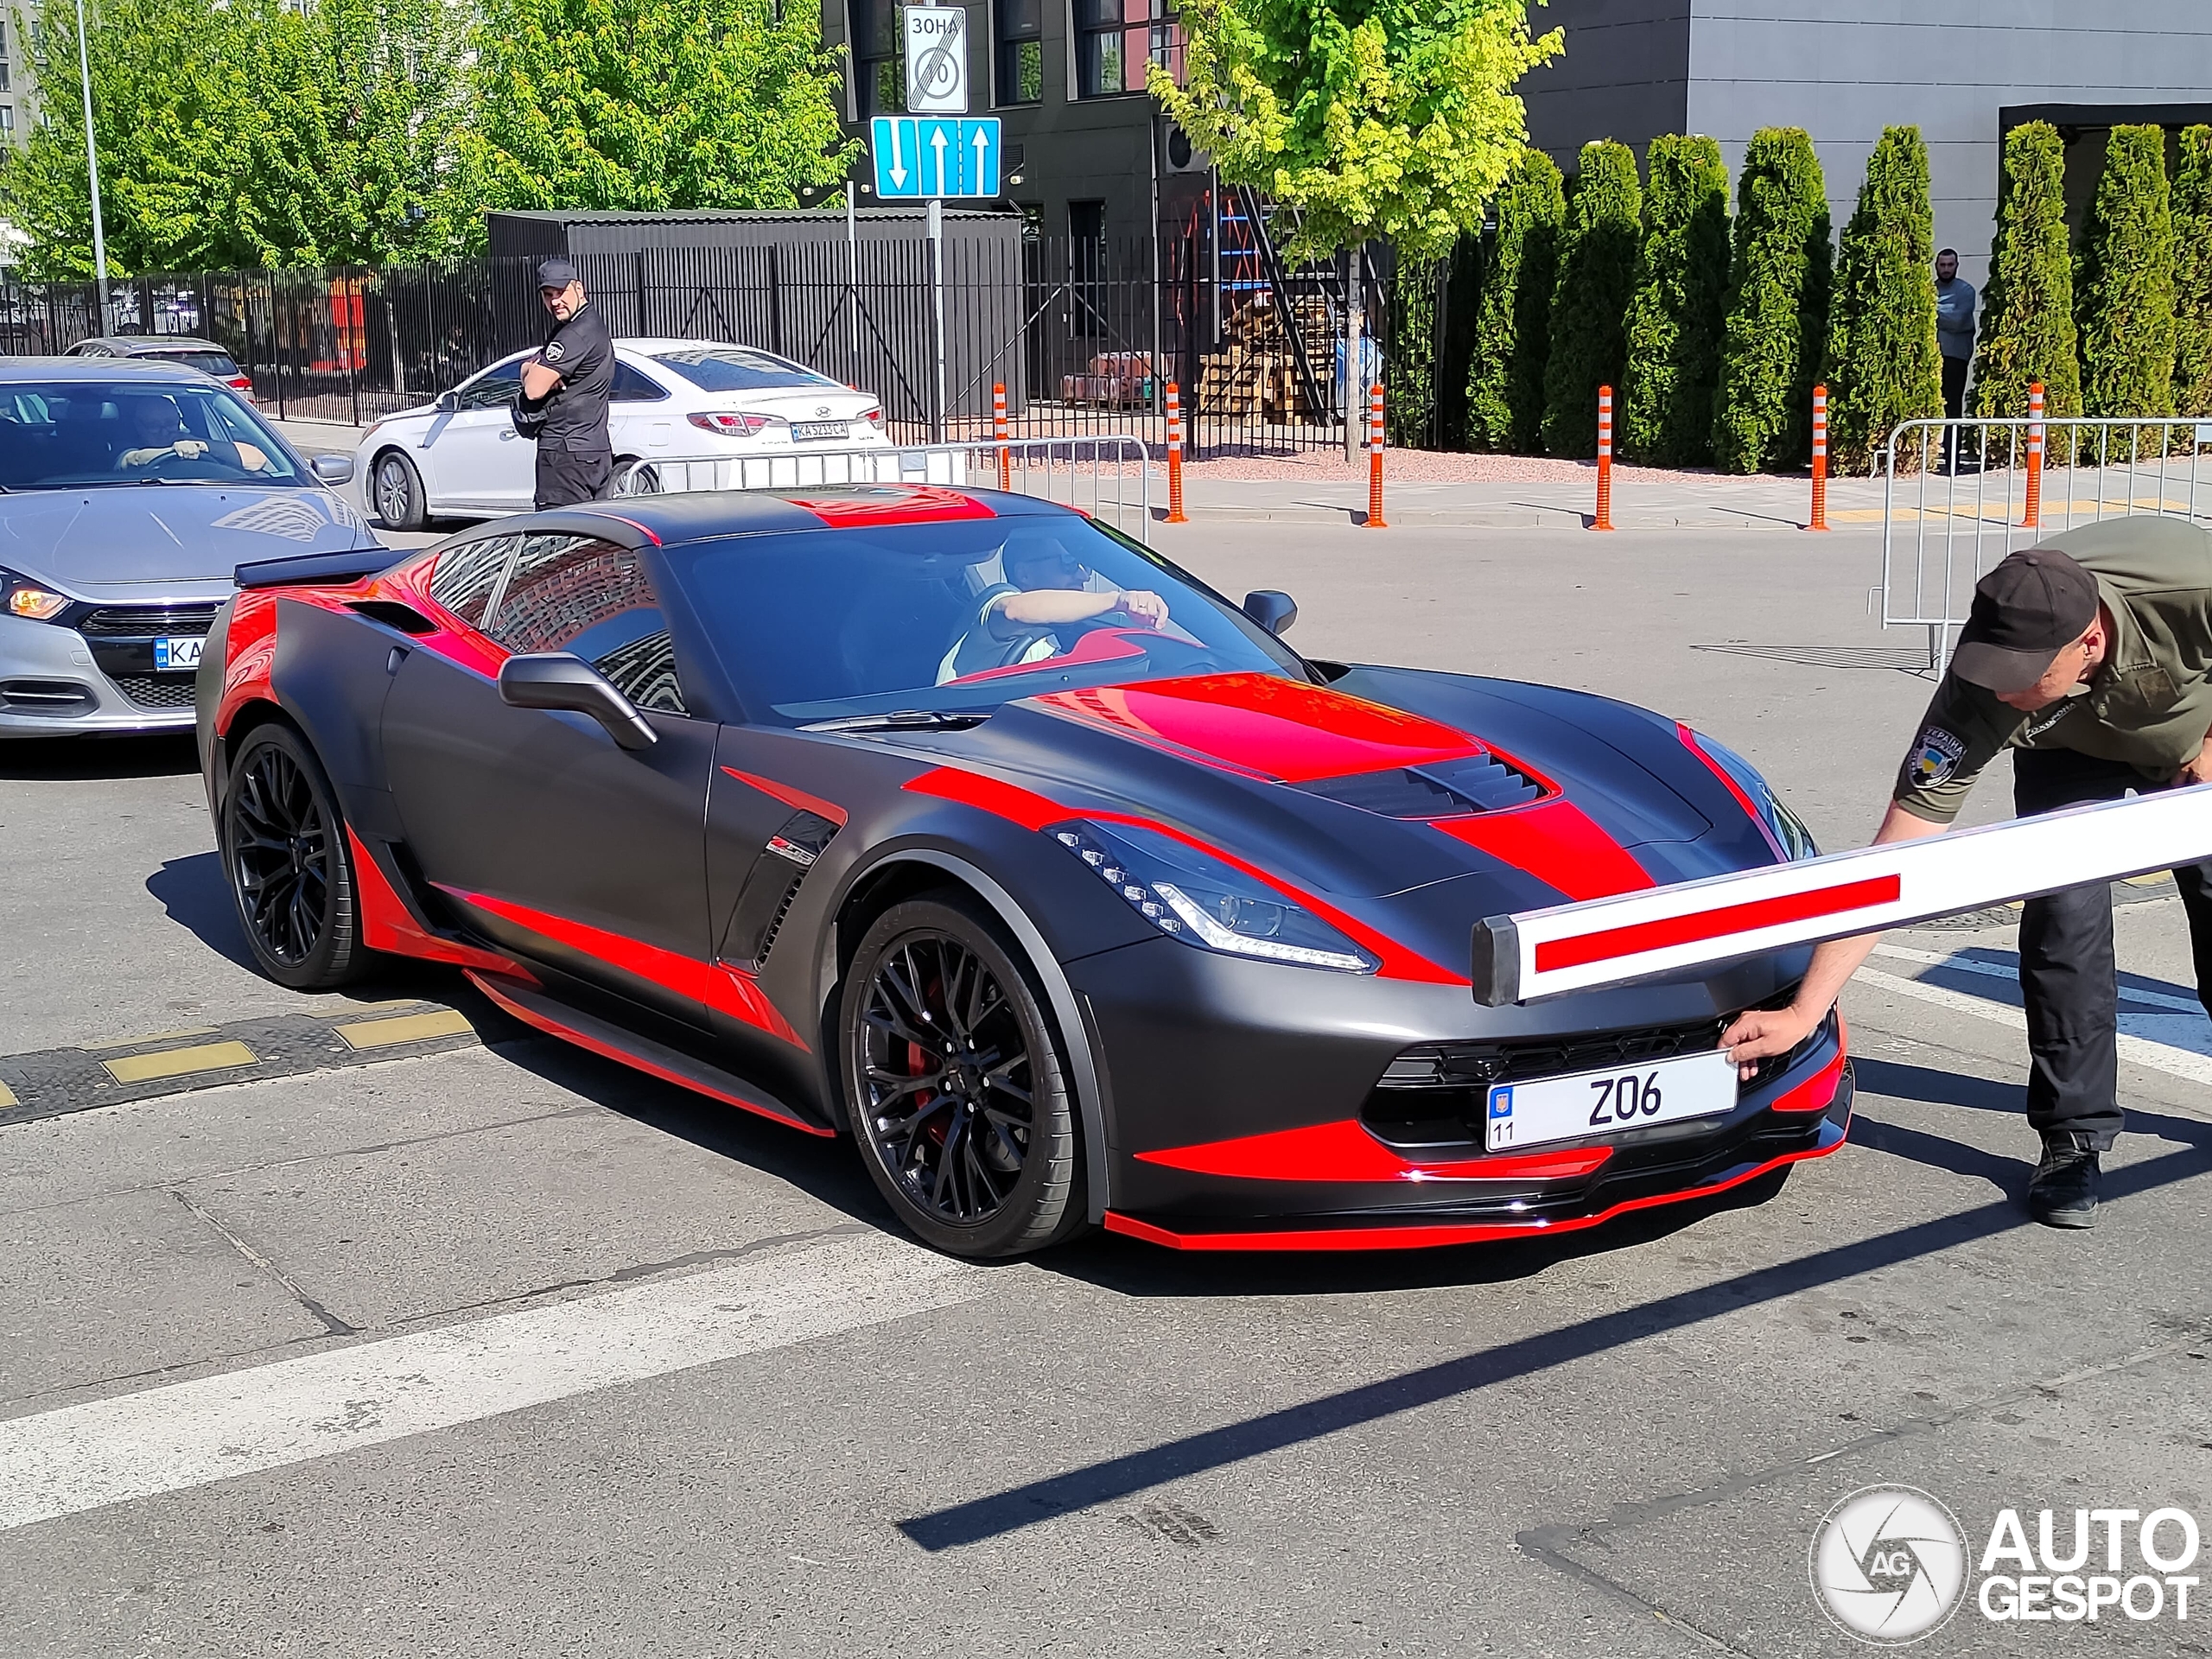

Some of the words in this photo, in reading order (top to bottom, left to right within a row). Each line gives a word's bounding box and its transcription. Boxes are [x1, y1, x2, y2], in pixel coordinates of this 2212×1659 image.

[171, 641, 201, 663] KA
[1589, 1071, 1661, 1126] Z06
[1493, 1122, 1513, 1142] 11
